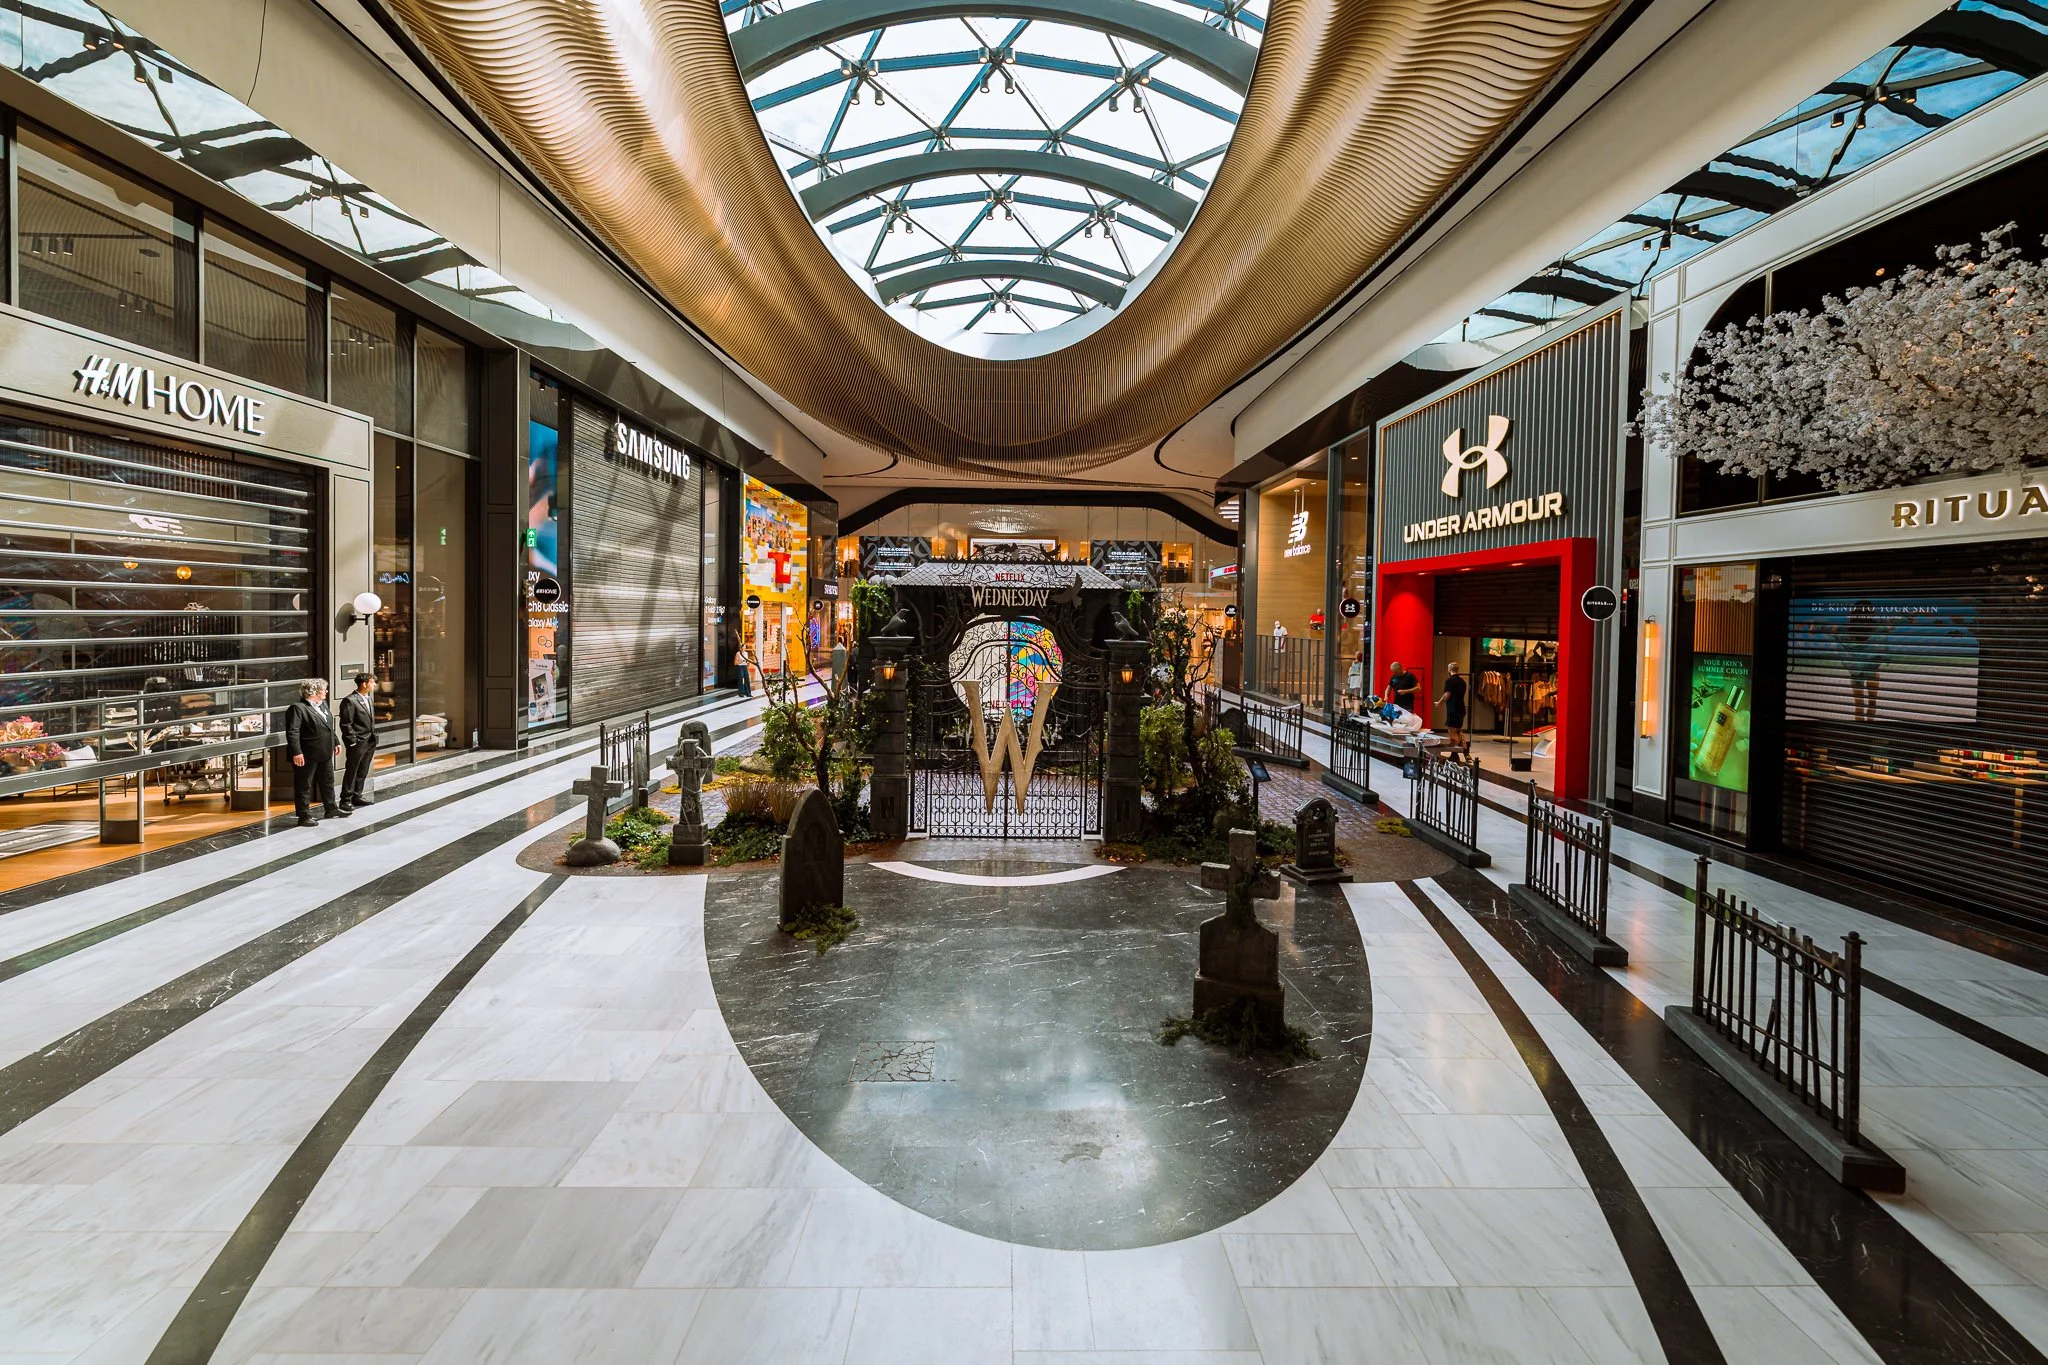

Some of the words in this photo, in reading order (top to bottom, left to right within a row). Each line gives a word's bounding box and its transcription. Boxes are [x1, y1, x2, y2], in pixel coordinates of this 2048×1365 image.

[76, 354, 142, 405] H&M
[145, 369, 265, 435] HOME
[616, 422, 691, 480] SAMSUNG
[1404, 514, 1460, 544] UNDER
[1462, 491, 1562, 533] ARMOUR
[1891, 486, 2048, 528] RITUA
[1293, 544, 1311, 556] balance
[995, 573, 1025, 582] NETFLIX
[970, 585, 1050, 609] WEDNESDAY
[1698, 666, 1724, 674] SUMMER
[1725, 667, 1749, 676] CRUSH
[1703, 659, 1721, 667] YOUR
[1722, 660, 1743, 668] SKIN'S
[951, 680, 1063, 816] W
